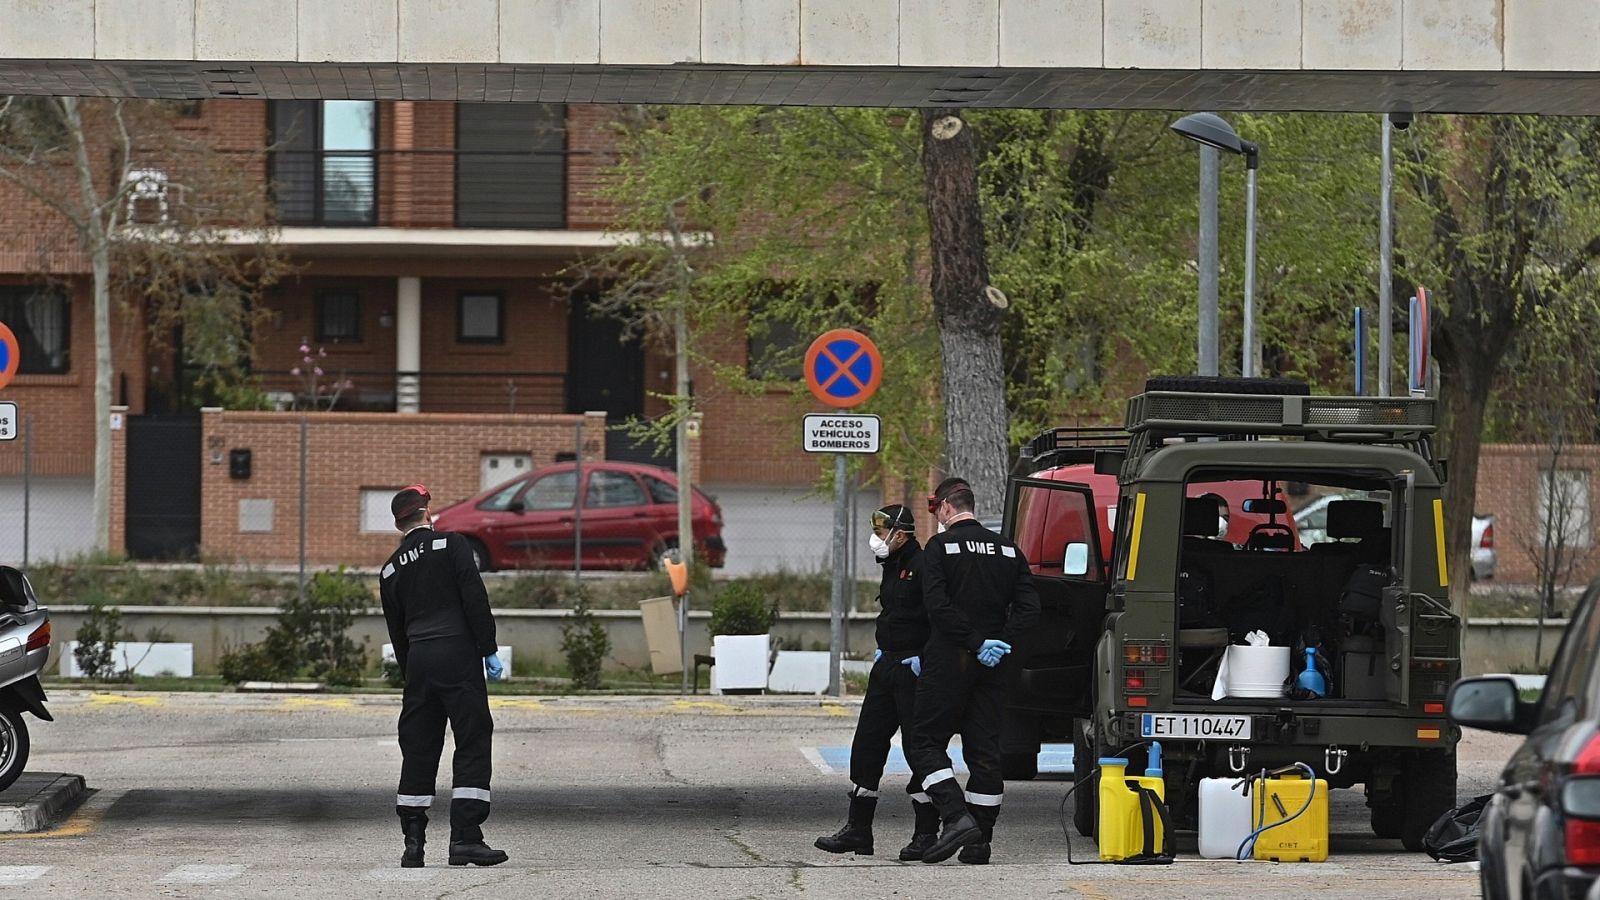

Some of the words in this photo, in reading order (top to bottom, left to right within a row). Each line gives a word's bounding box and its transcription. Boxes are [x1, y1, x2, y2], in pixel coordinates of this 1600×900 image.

[820, 420, 863, 428] ACCESO
[812, 429, 871, 438] VEHÍCULOS
[812, 440, 870, 448] BOMBEROS
[966, 541, 995, 554] UME
[1155, 717, 1176, 734] ET
[1182, 718, 1245, 736] 110447
